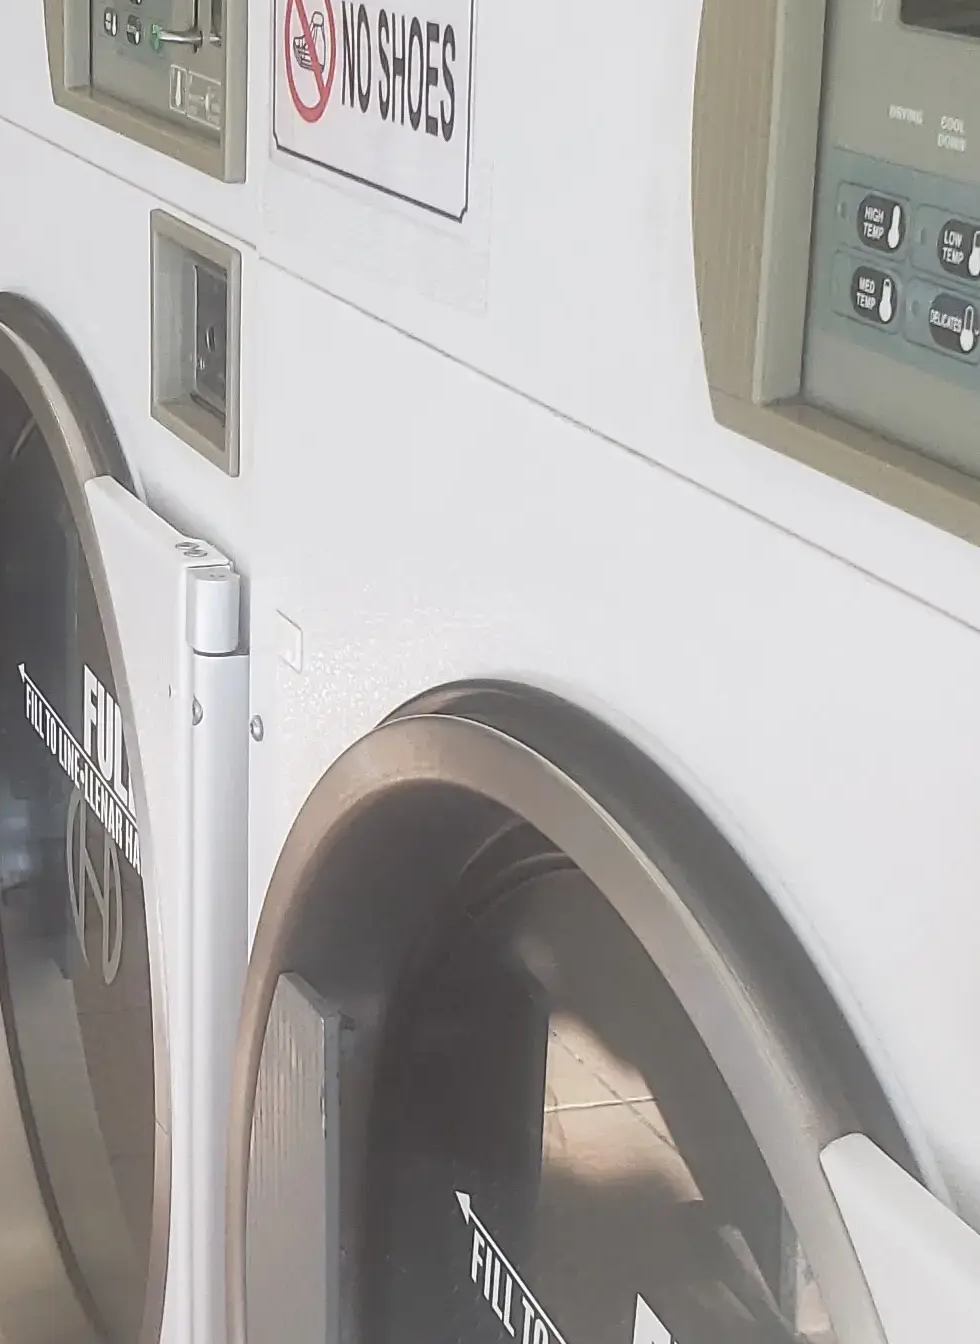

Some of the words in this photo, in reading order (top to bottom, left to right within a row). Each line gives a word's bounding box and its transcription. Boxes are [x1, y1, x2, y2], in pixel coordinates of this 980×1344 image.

[341, 0, 371, 114] NO
[378, 8, 456, 143] SHOES
[940, 114, 966, 134] COOL
[864, 206, 885, 224] HIGH
[863, 222, 885, 240] TEMP
[944, 230, 964, 248] LOW
[942, 247, 965, 265] TEMP
[858, 277, 877, 294] MED
[856, 292, 878, 311] TEMP
[929, 309, 964, 334] DELICATES
[25, 682, 45, 740] FILL
[45, 706, 57, 755] TO
[469, 1228, 516, 1338] FILL
